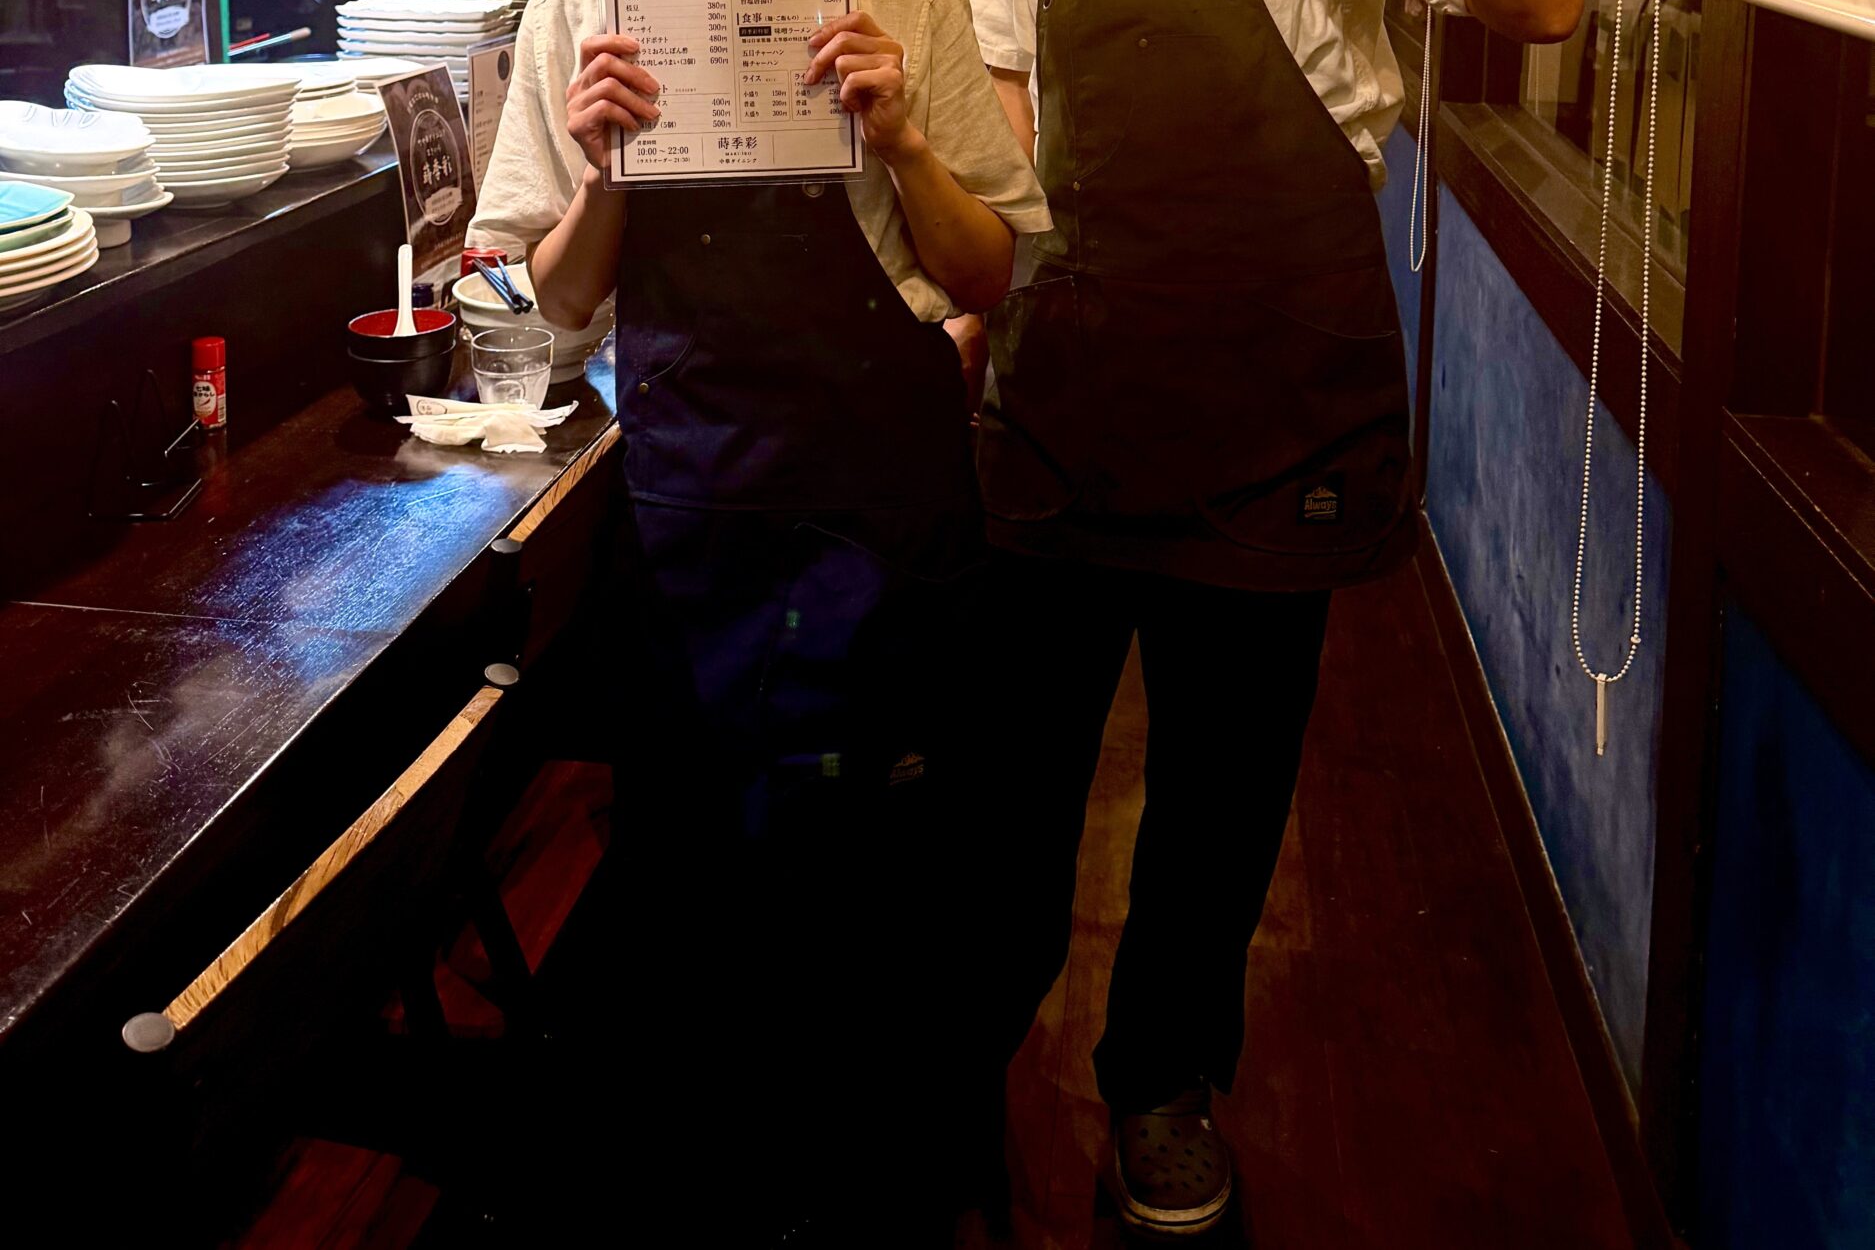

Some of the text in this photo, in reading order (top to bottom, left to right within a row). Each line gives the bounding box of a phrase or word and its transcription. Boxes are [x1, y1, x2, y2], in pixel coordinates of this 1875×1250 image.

[707, 2, 726, 10] 380円
[708, 13, 727, 21] 300円
[742, 12, 762, 24] 食事
[635, 34, 728, 44] ライドポテト 480円
[709, 45, 728, 53] 690円
[710, 56, 729, 65] 690円
[711, 98, 731, 106] 400円
[712, 109, 731, 117] 500円
[712, 120, 732, 128] 500円
[637, 147, 657, 156] 10:00
[668, 146, 689, 155] 22:00
[1304, 498, 1337, 511] Always
